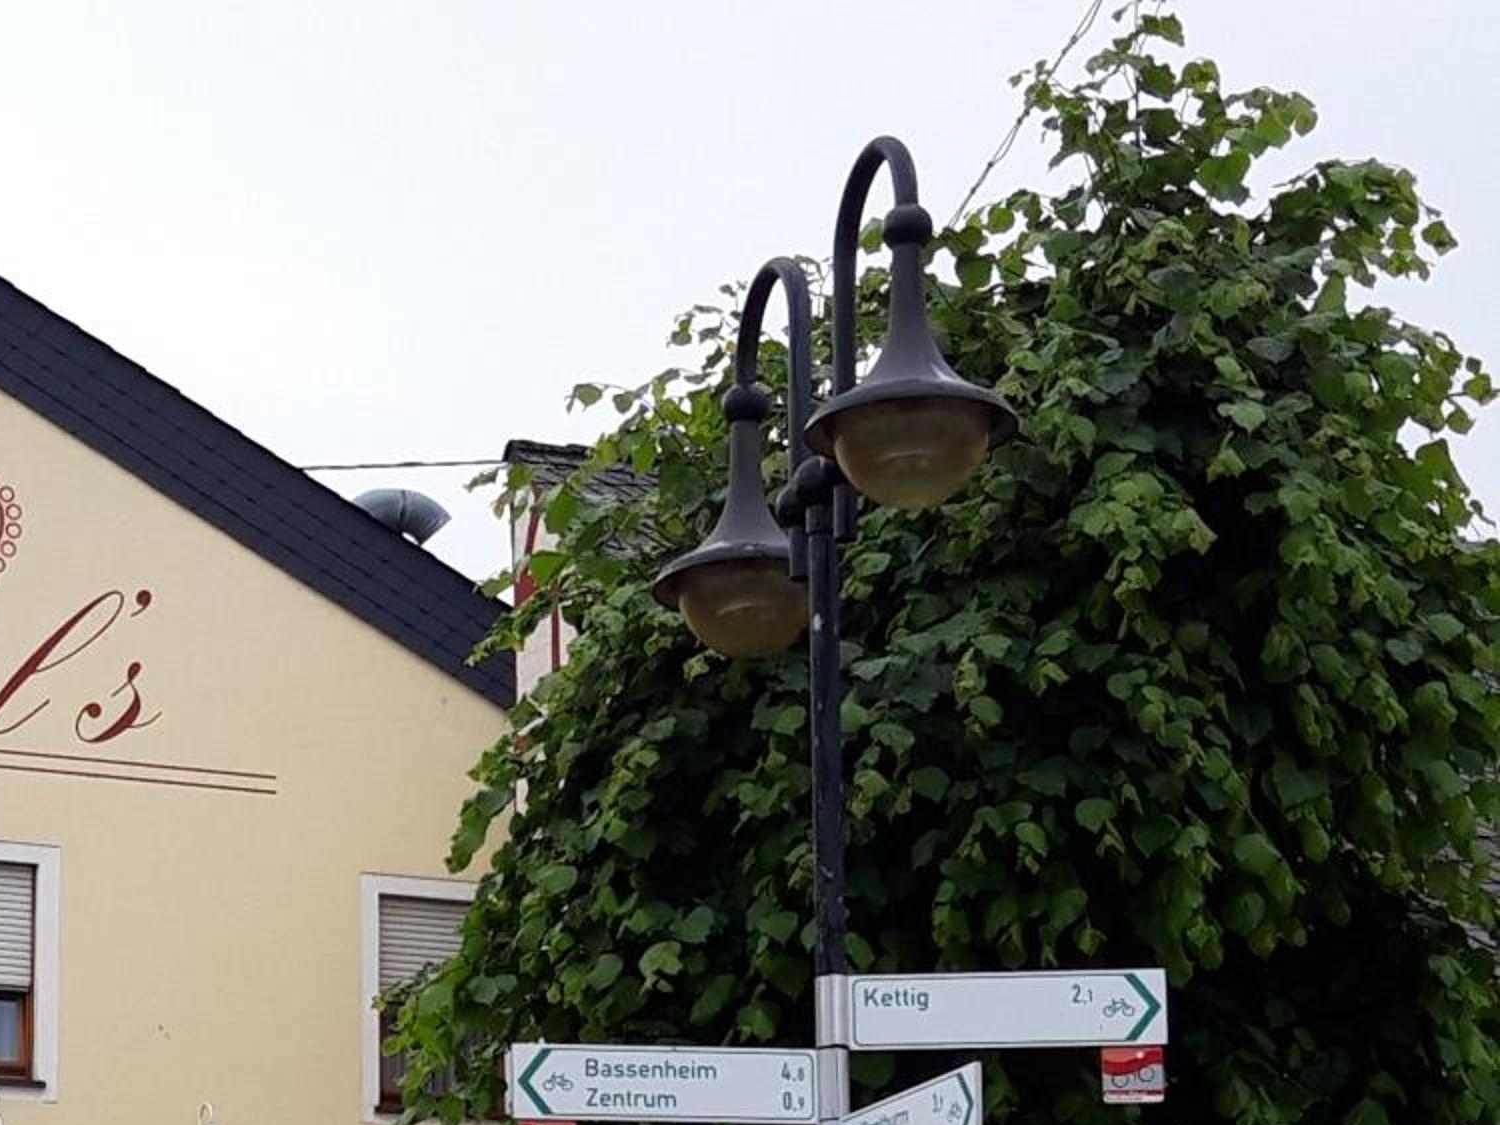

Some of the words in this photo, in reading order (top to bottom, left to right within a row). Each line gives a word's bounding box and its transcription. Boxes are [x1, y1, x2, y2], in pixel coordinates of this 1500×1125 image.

[864, 988, 930, 1011] Kettig
[584, 1058, 718, 1080] Bassenheim
[586, 1088, 678, 1109] Zentrum
